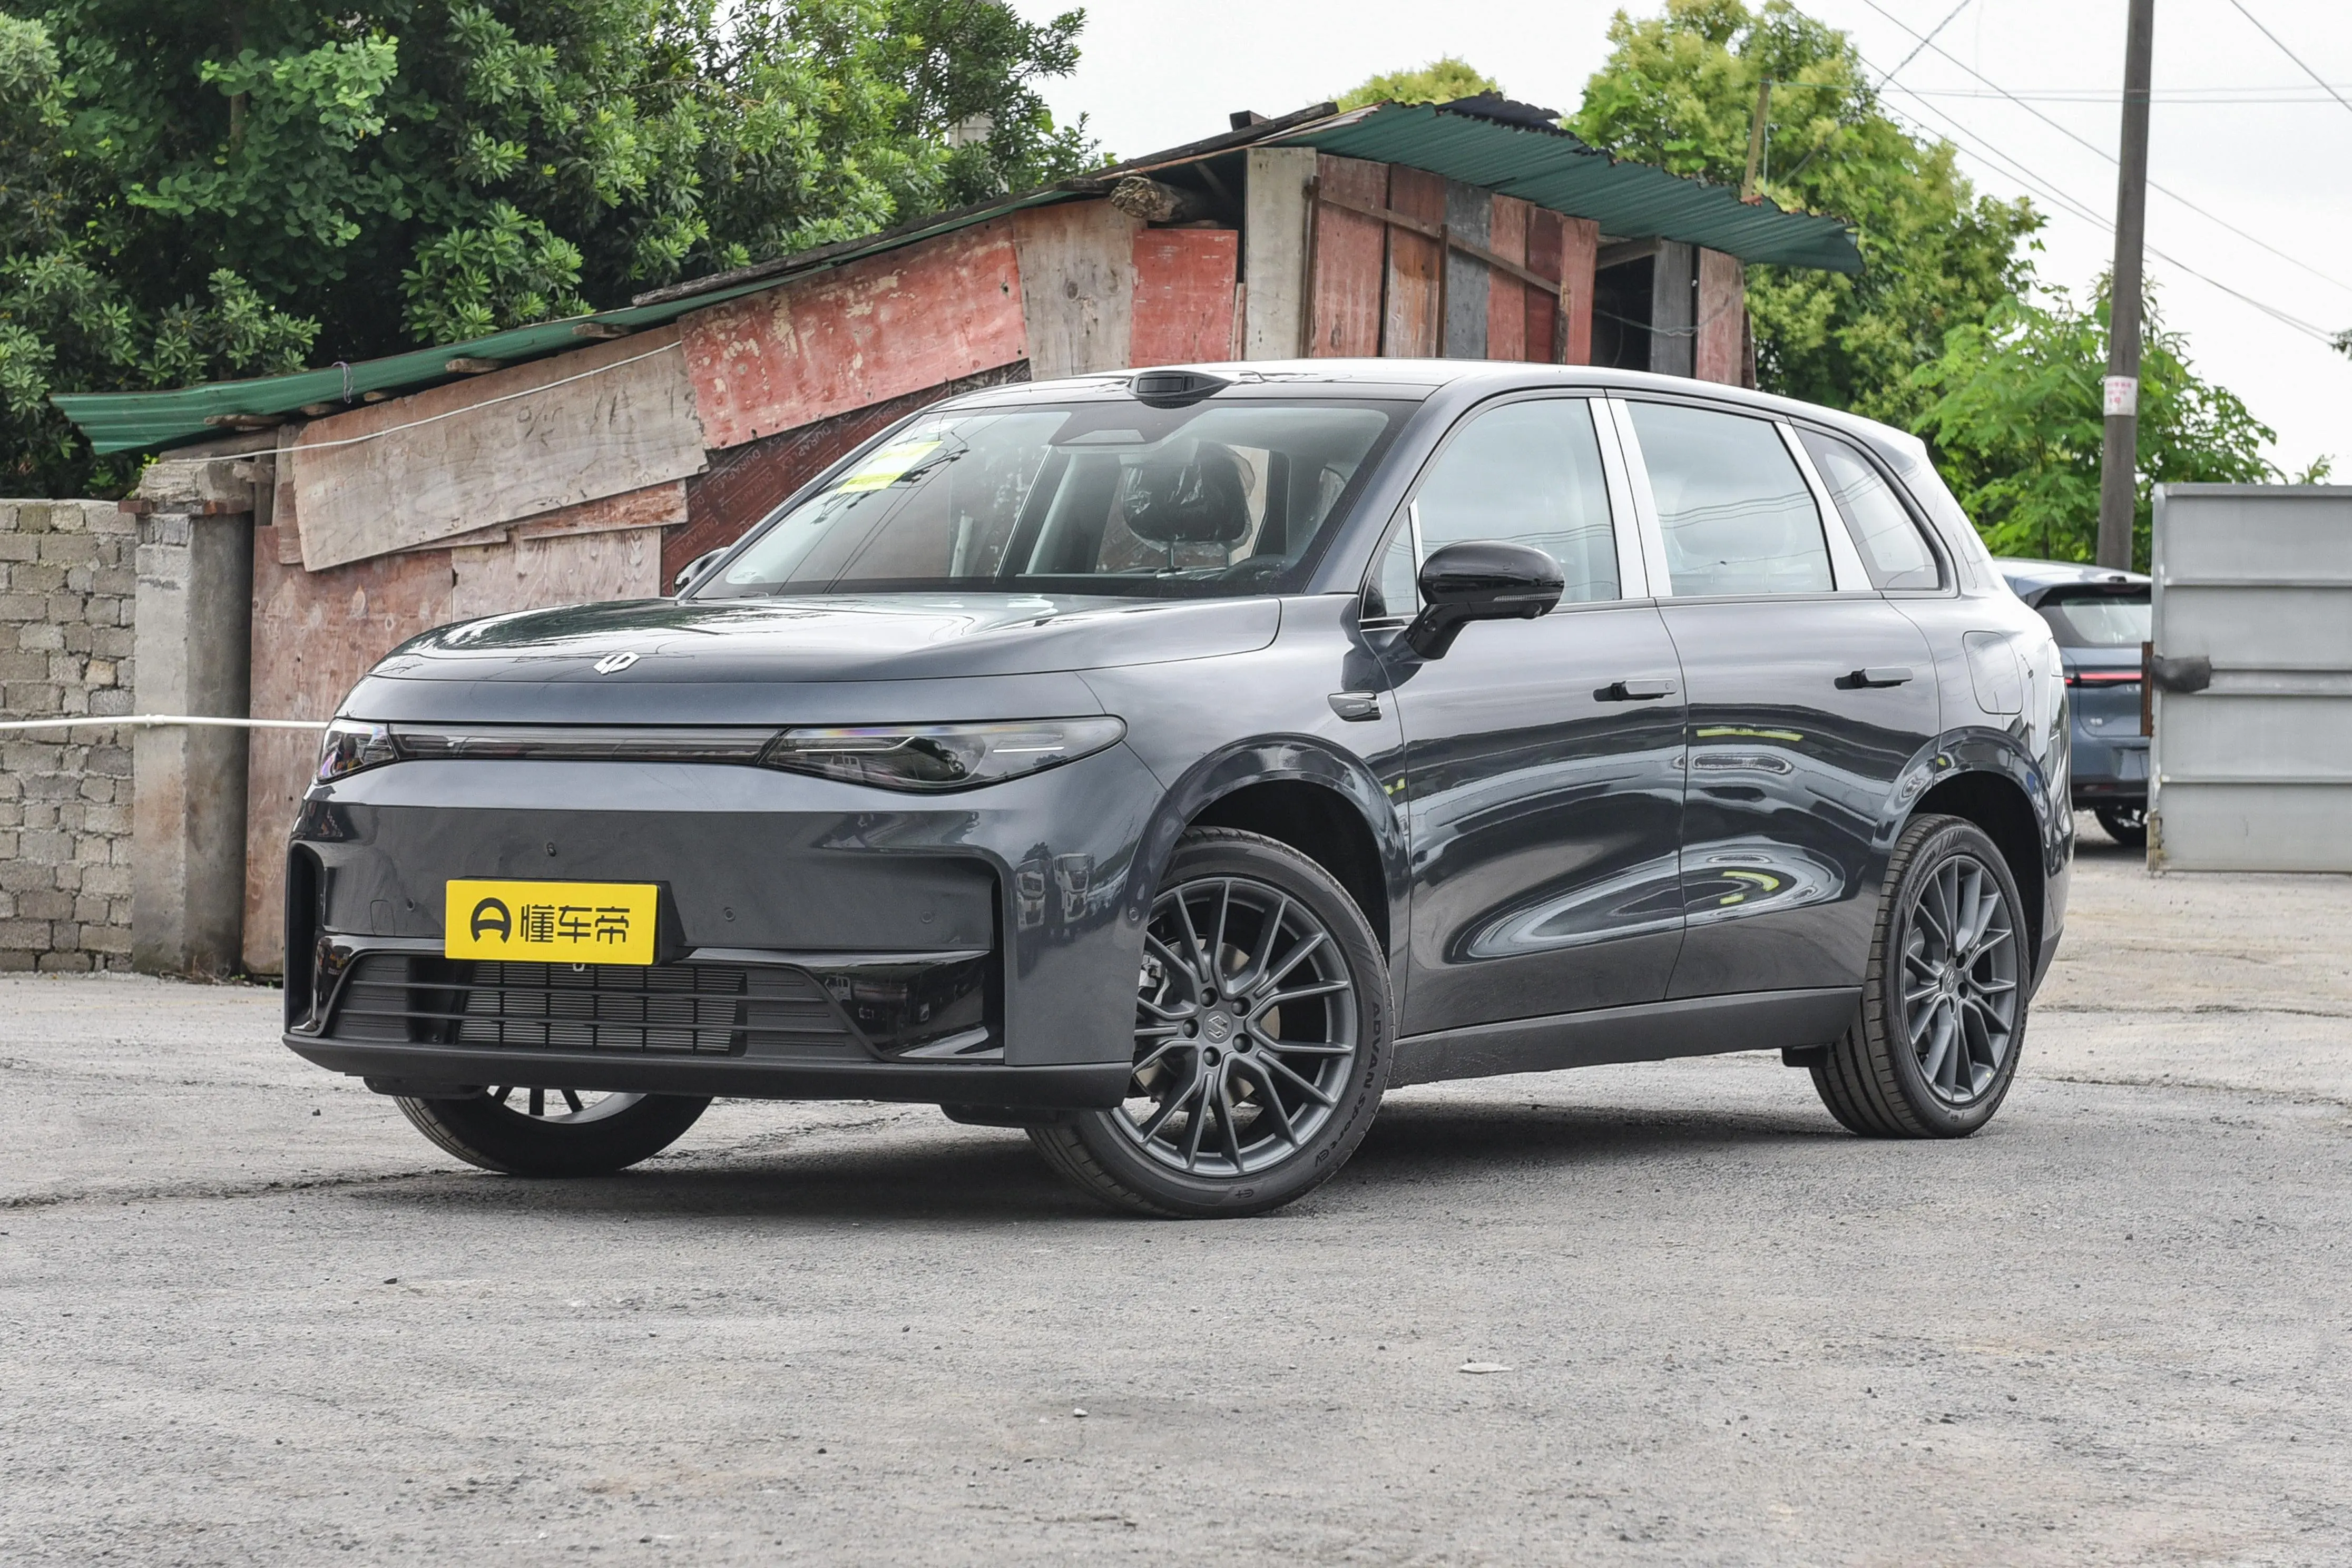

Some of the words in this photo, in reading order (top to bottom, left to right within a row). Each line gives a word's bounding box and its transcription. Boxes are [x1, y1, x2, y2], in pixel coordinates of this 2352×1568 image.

[709, 448, 762, 494] DURAPLEX
[778, 425, 832, 472] DURAPLEX
[520, 904, 631, 945] 懂车帝
[1364, 1002, 1381, 1089] ADVAN
